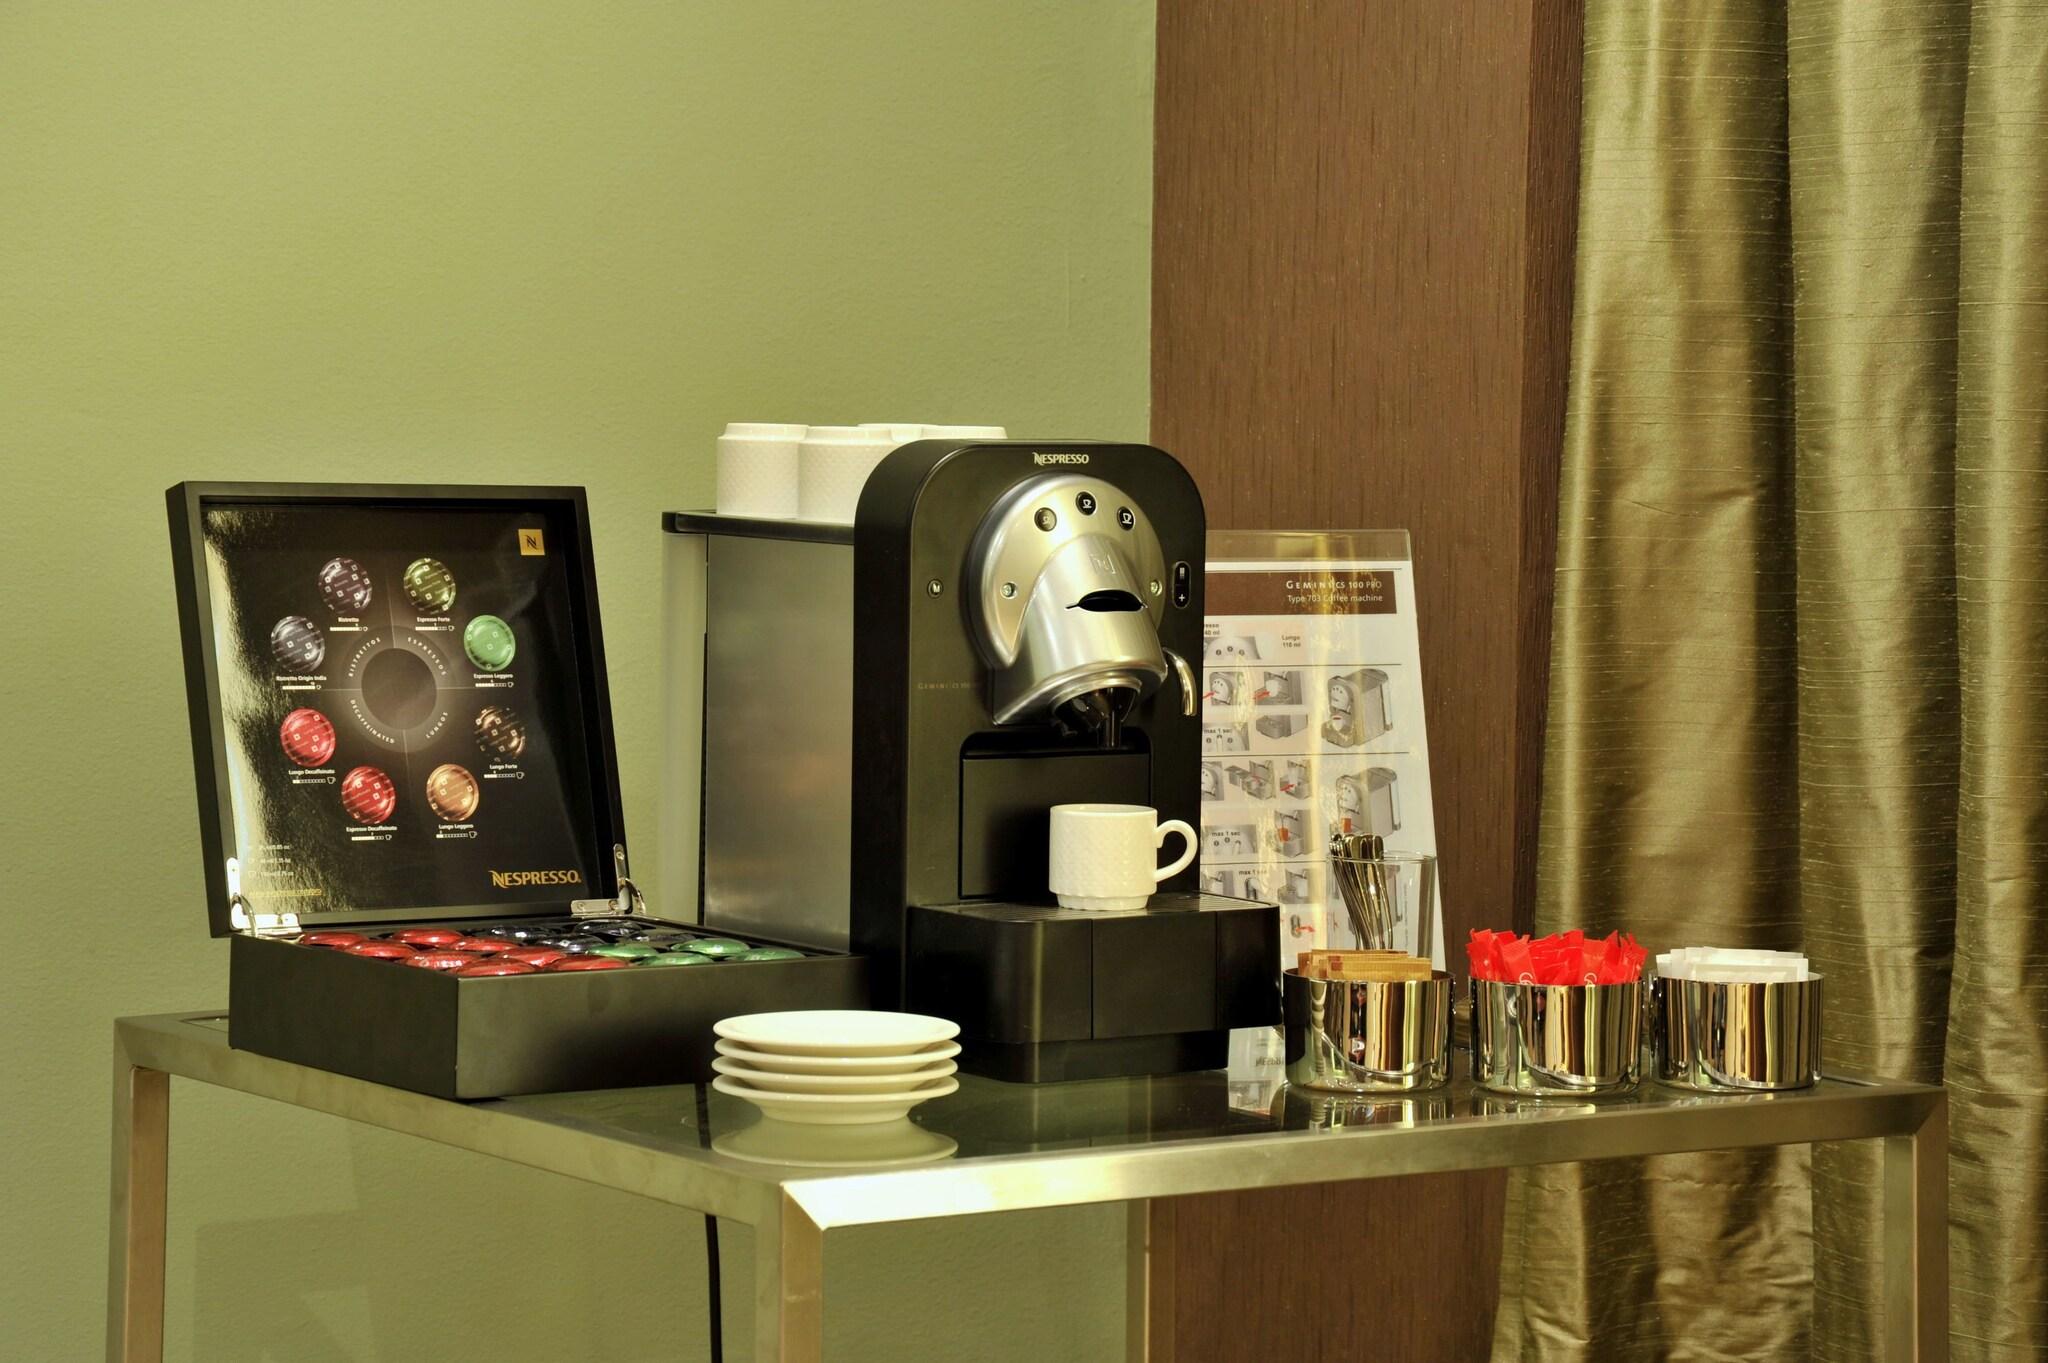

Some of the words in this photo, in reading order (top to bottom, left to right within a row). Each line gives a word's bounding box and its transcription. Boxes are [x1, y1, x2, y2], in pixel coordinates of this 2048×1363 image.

[1032, 451, 1089, 466] NESPRESSO
[1335, 581, 1346, 589] CS
[1348, 581, 1364, 589] 100
[1287, 594, 1306, 604] Type
[1350, 593, 1384, 602] machine
[348, 637, 381, 677] RISTRETTOS
[407, 636, 447, 676] ESPRESSOS
[350, 699, 395, 744] DECAFFEINATED
[425, 711, 449, 739] LUNGOS
[488, 869, 580, 888] NESPRESSO
